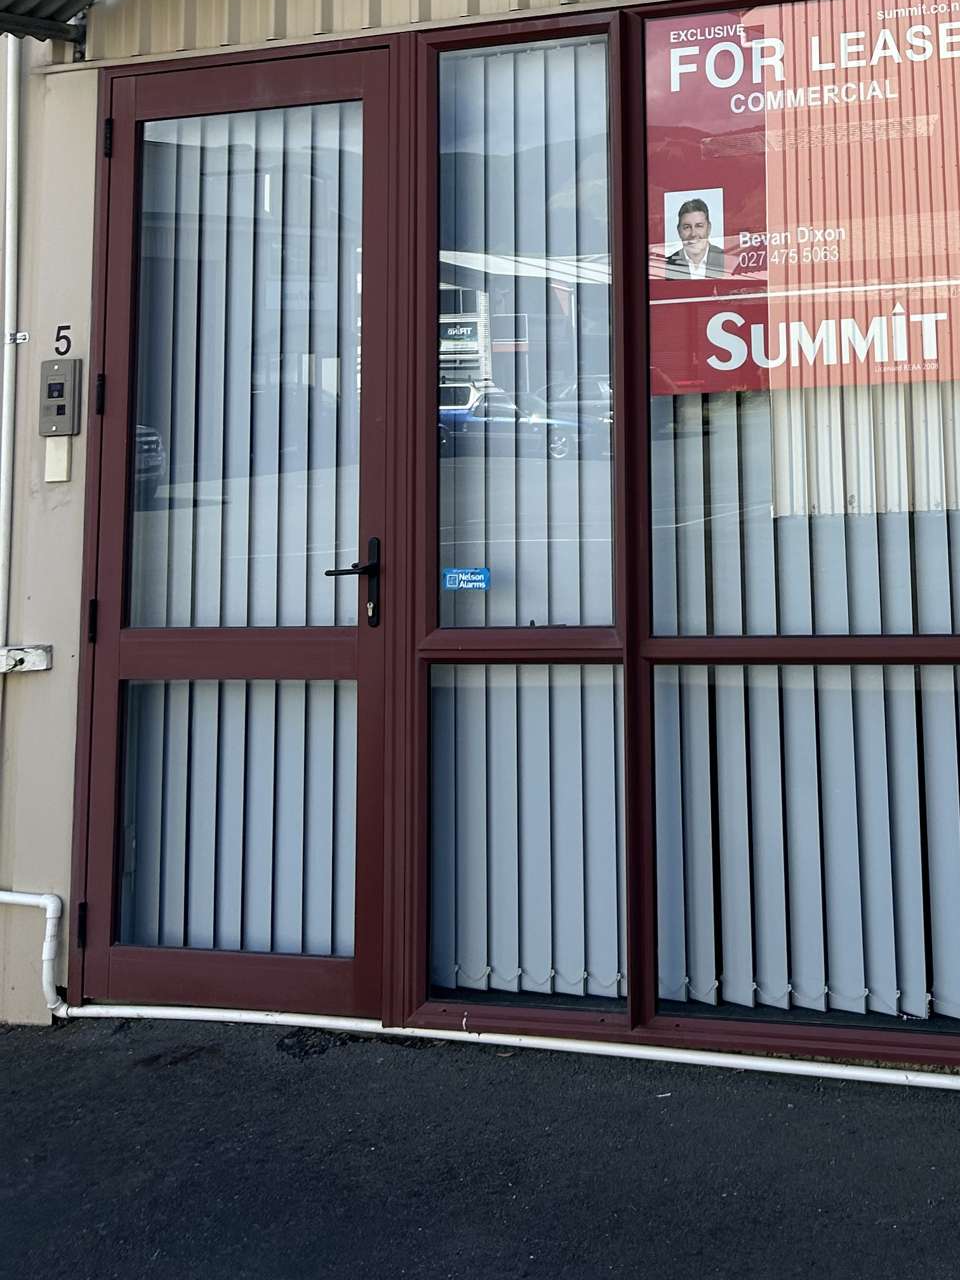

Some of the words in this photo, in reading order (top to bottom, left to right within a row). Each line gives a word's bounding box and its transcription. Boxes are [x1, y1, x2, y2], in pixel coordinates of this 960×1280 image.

[669, 23, 745, 43] EXCLUSIVE
[669, 37, 786, 92] FOR
[730, 79, 899, 113] COMMERCIAL
[738, 229, 791, 248] Bevan
[796, 226, 846, 242] Dixon
[738, 251, 766, 268] 027
[770, 248, 798, 265] 475
[802, 245, 839, 263] 5063
[54, 325, 72, 356] 5
[705, 302, 948, 371] SUMMIT
[458, 572, 485, 581] Nelson
[459, 580, 486, 589] Alarms
